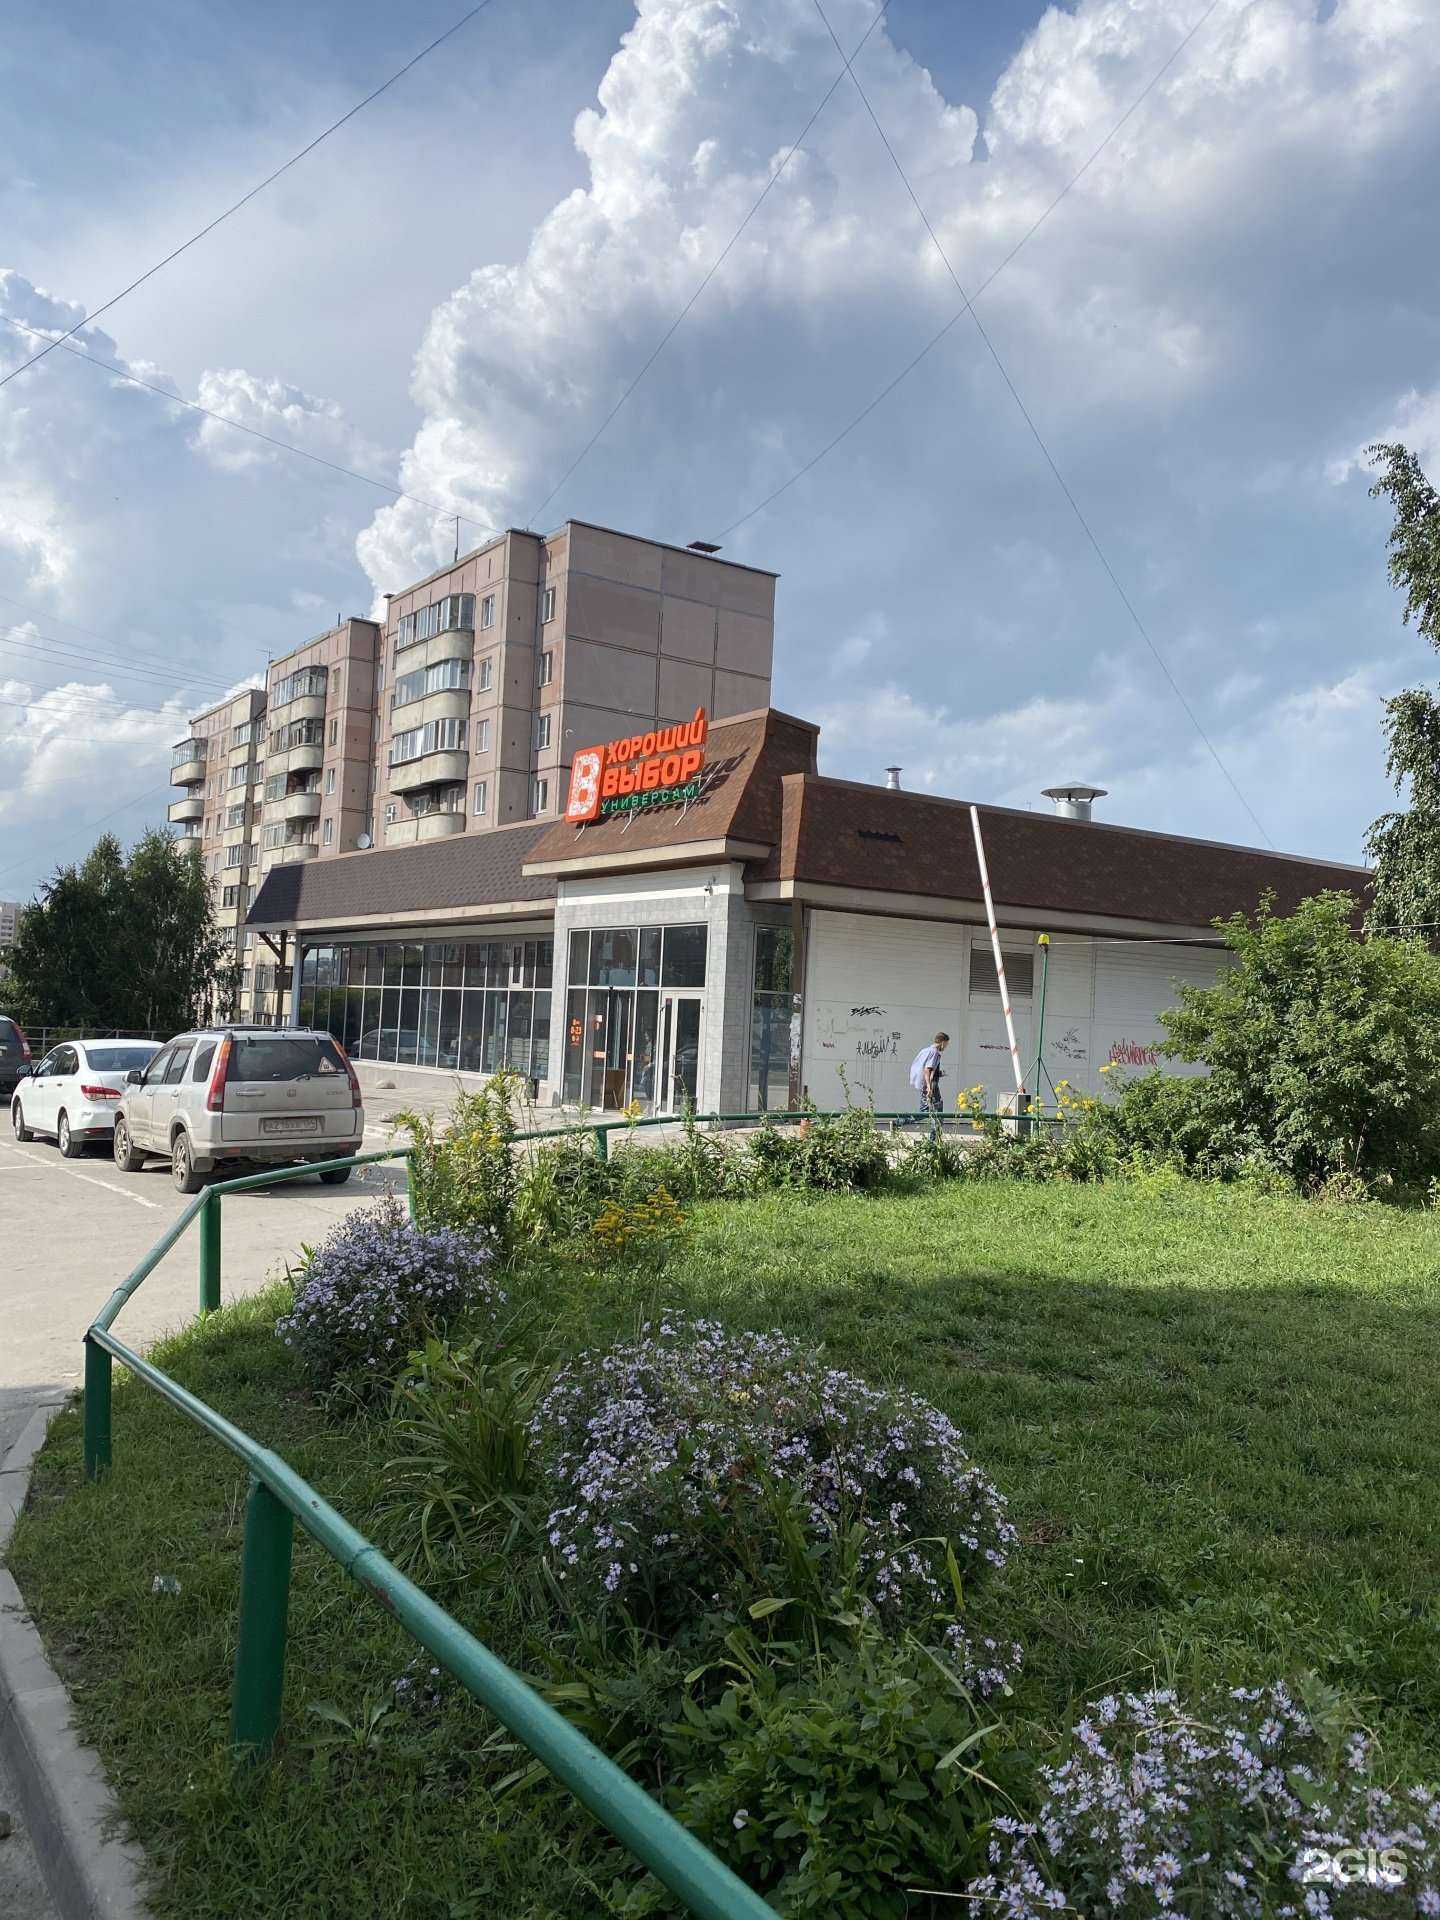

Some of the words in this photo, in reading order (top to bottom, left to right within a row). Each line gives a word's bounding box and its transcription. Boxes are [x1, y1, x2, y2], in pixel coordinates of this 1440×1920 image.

[606, 706, 706, 764] ХОРОШИЙ
[602, 749, 702, 797] ВЫБОР
[601, 784, 697, 813] УНИВЕРСАМ
